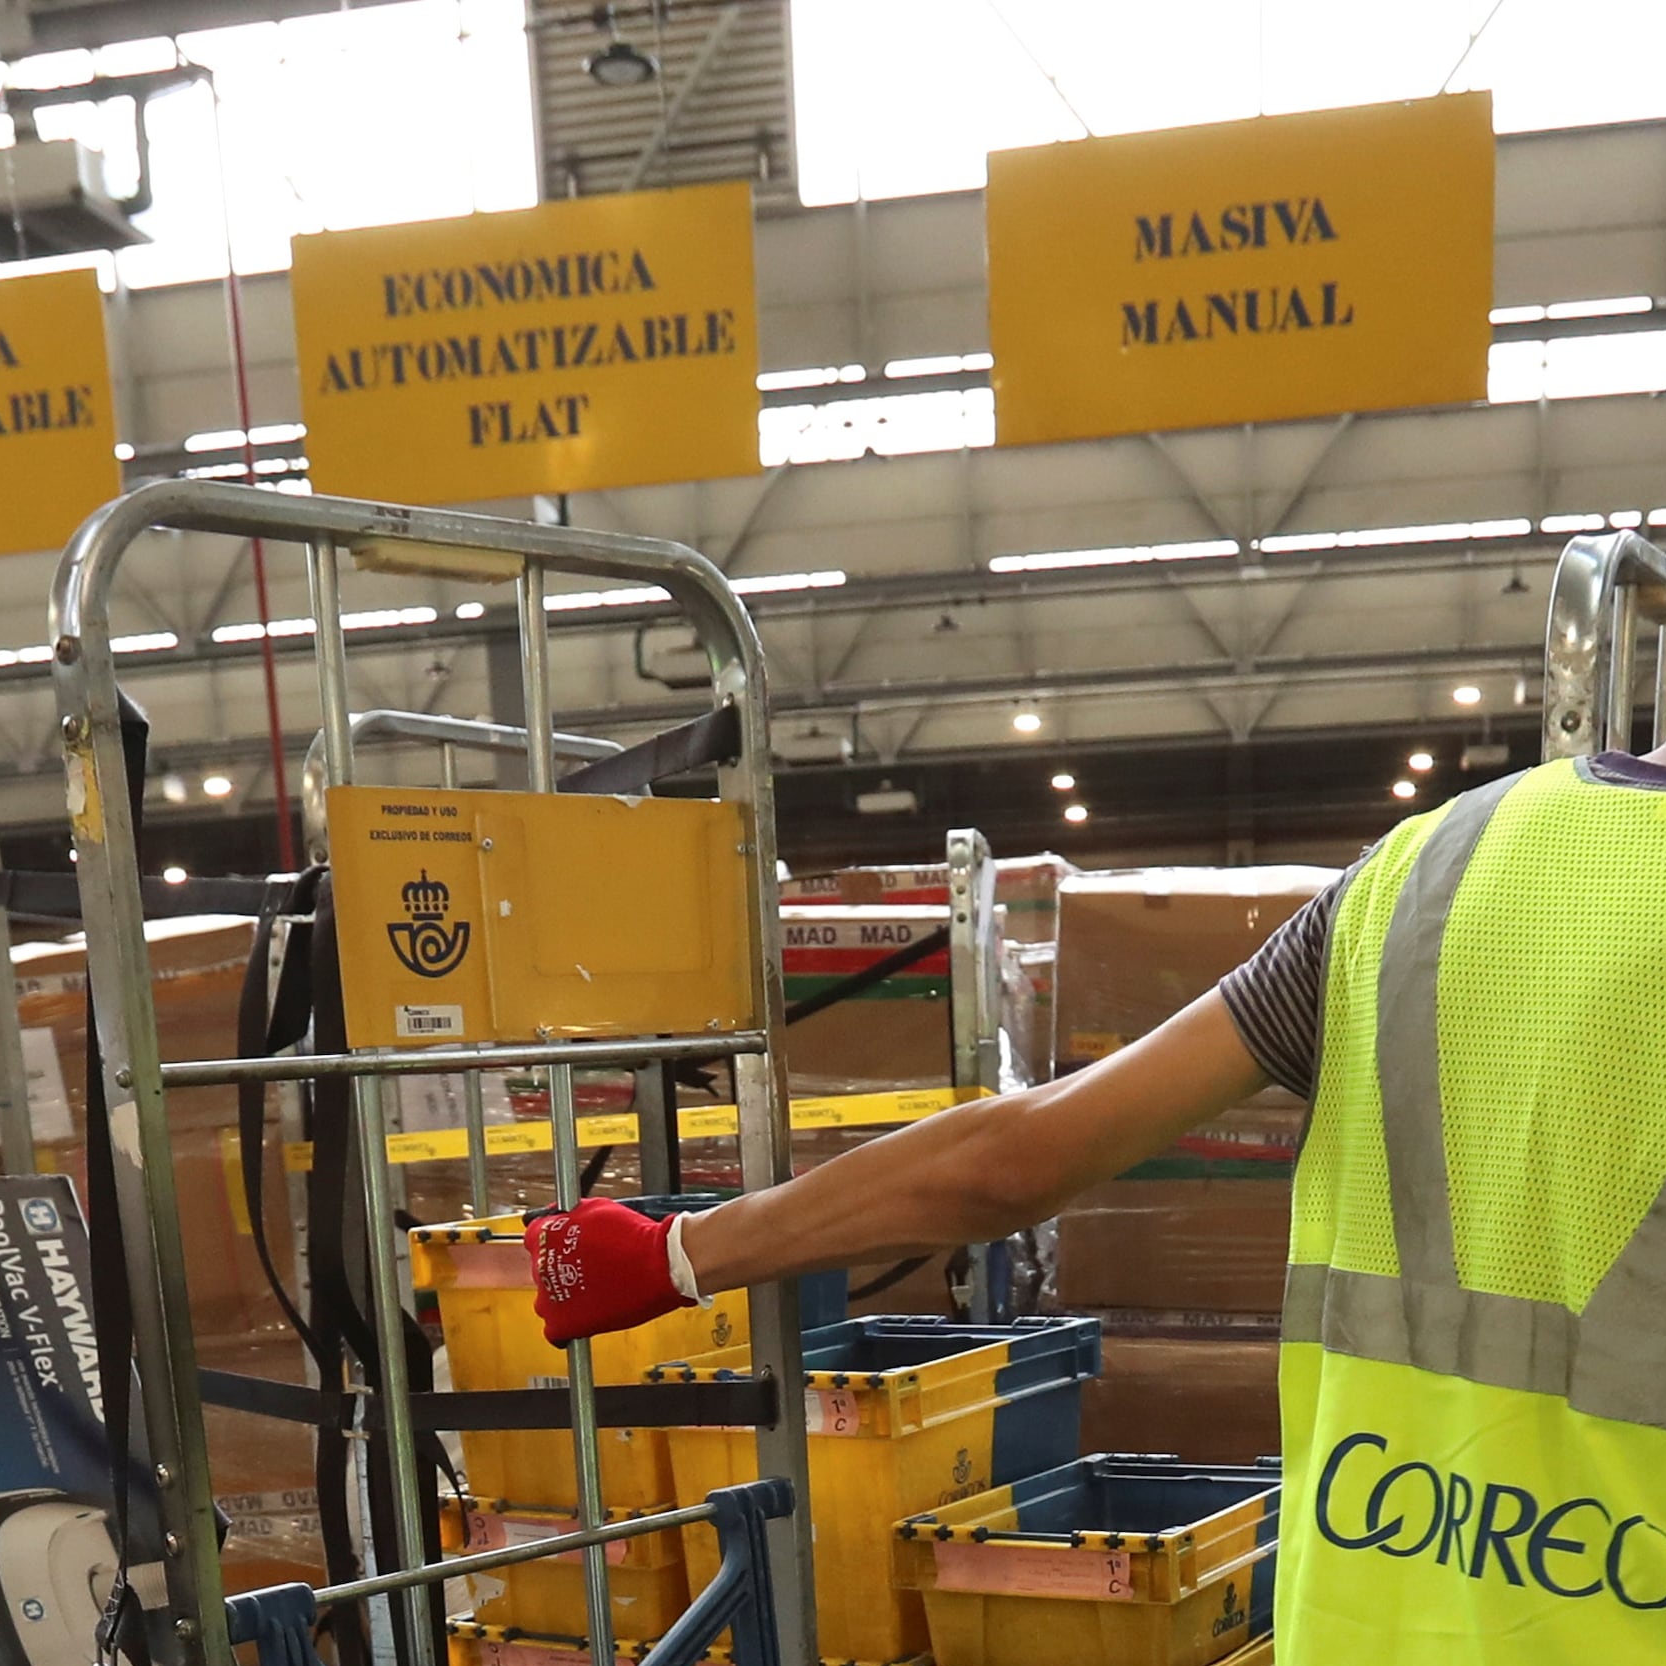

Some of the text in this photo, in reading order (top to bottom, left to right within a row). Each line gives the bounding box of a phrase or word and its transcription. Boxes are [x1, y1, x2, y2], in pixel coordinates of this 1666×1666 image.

[1134, 198, 1338, 262] MASIVA
[1121, 284, 1354, 349] MANUAL
[320, 309, 736, 396] AUTOMATIZABLE
[469, 395, 591, 448] FLAT
[381, 804, 430, 817] PROPIEDAD
[439, 806, 458, 817] USO
[370, 830, 472, 843] EXCLUSIVO DE CORREOS
[786, 924, 912, 946] MAD MAD
[835, 1418, 846, 1431] C
[1108, 1579, 1122, 1594] C
